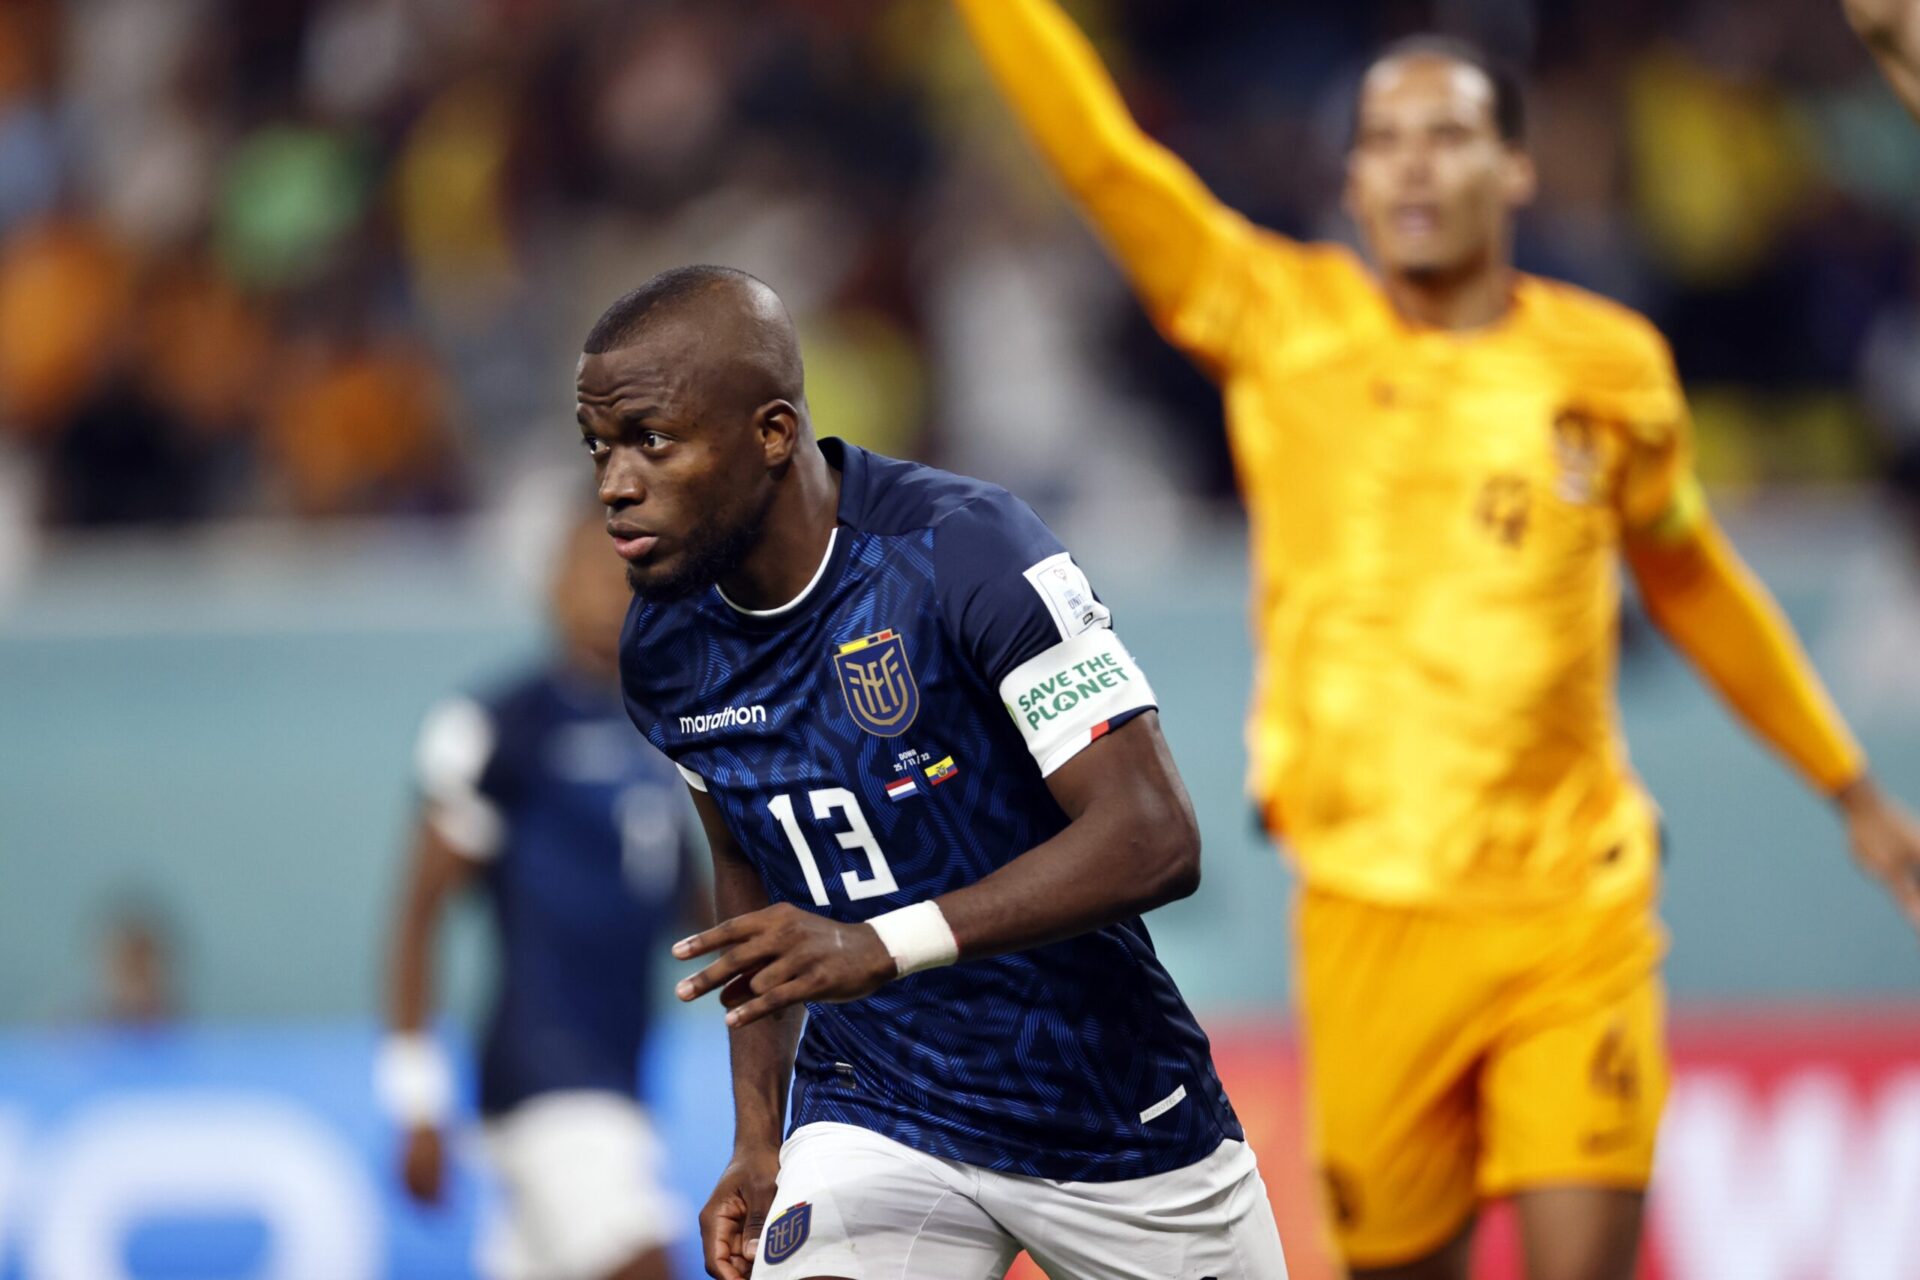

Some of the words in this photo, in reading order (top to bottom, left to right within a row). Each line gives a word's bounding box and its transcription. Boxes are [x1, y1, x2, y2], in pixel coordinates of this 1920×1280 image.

[1018, 670, 1073, 712] SAVE
[1072, 652, 1117, 678] THE
[679, 704, 766, 734] marathon
[767, 787, 899, 906] 13
